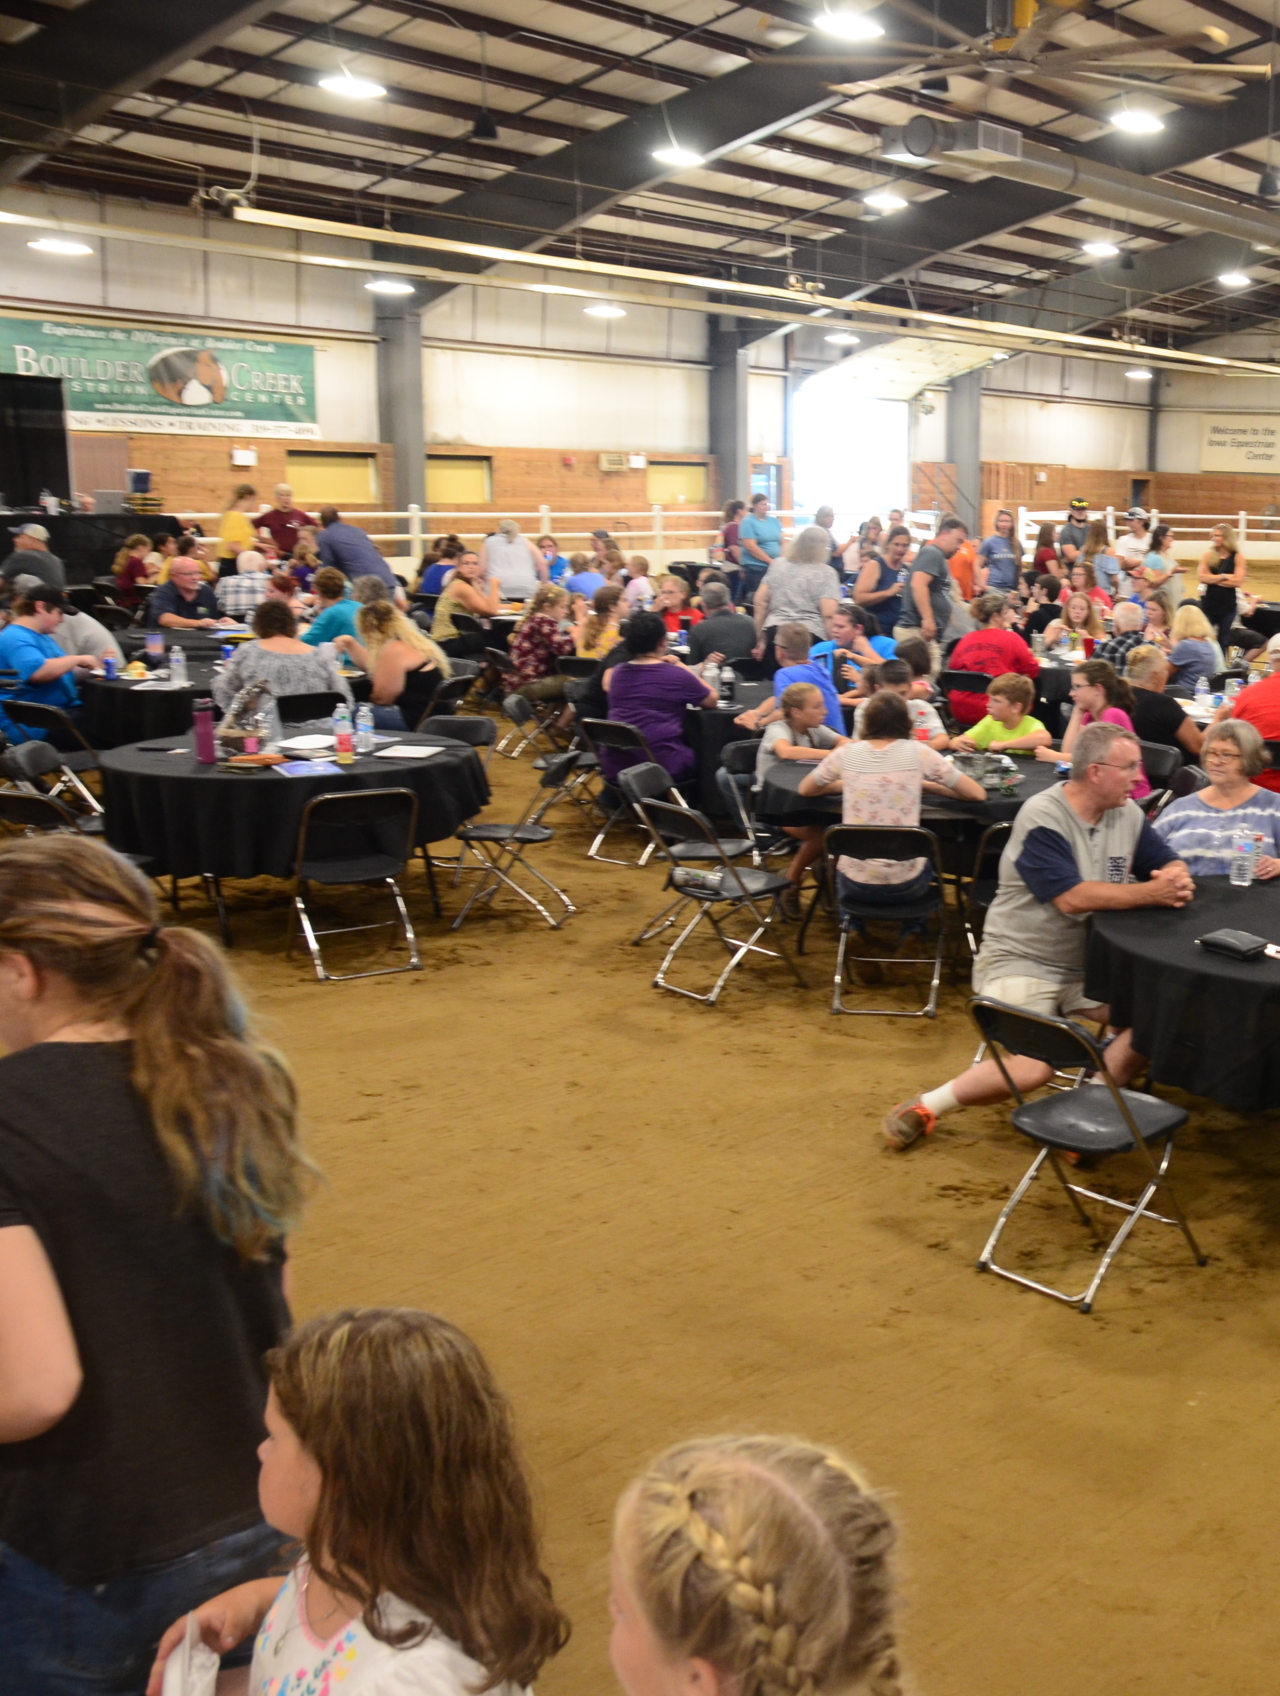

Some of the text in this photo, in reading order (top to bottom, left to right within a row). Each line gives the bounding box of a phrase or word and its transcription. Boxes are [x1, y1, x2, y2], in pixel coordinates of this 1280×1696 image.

[12, 344, 306, 394] BOULDER CREEK
[70, 381, 308, 406] STRIAN CENTER
[1210, 425, 1277, 436] Welcome to the
[1206, 437, 1276, 450] Iowa Equestrian
[1245, 451, 1275, 461] Center
